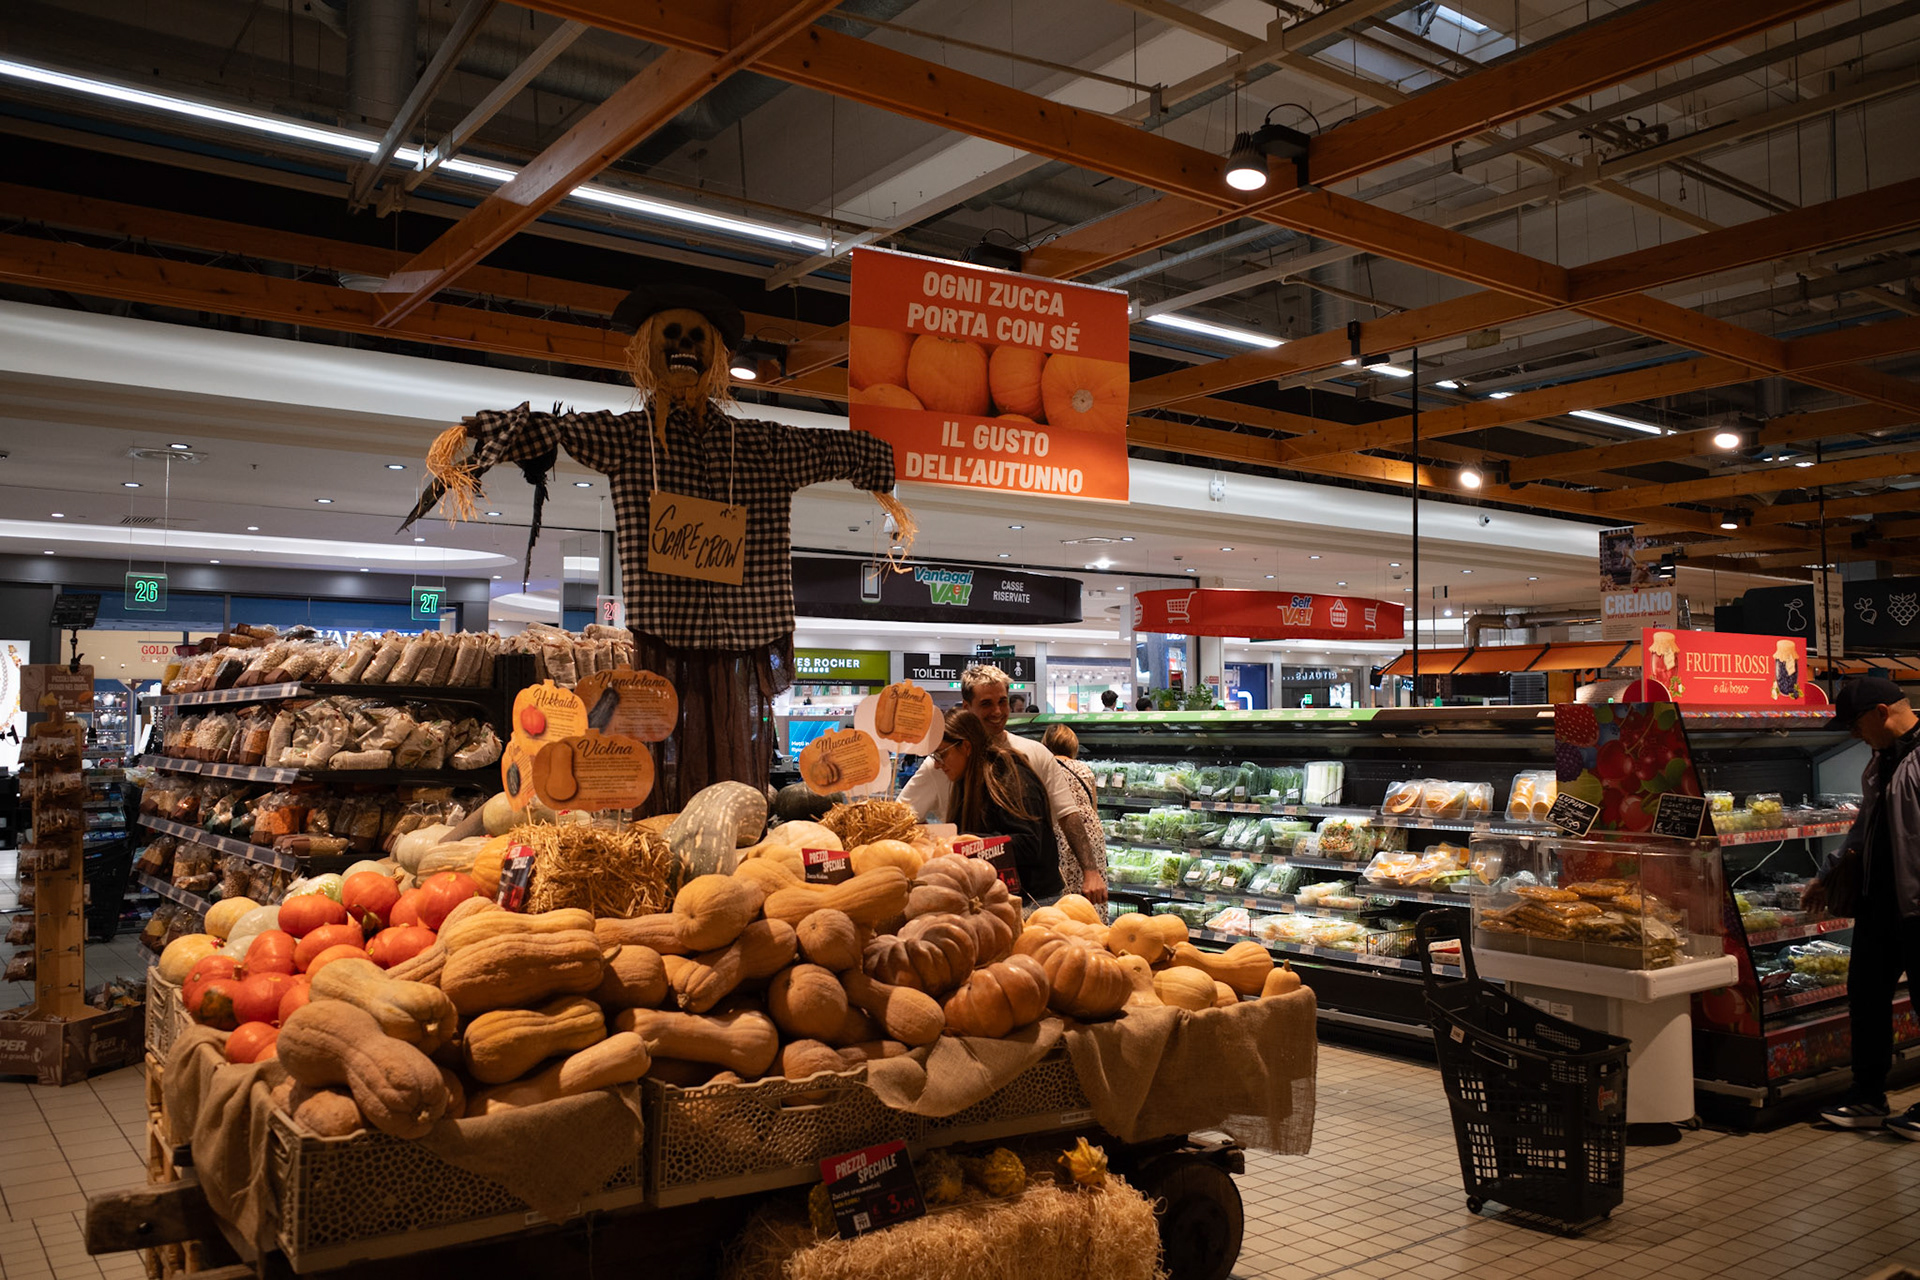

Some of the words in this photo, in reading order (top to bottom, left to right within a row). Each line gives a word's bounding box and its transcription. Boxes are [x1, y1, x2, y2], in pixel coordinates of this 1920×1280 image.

[923, 271, 982, 304] OGNI
[988, 281, 1064, 317] ZUCCA
[907, 302, 989, 338] PORTA
[996, 316, 1043, 347] CON
[1049, 322, 1081, 352] SÉ
[941, 421, 966, 448] IL
[972, 424, 1049, 457] GUSTO
[905, 452, 1083, 494] DELL'AUTUNNO
[915, 567, 974, 584] Vantaggi
[135, 581, 158, 602] 26
[1001, 580, 1024, 592] CASSE
[420, 593, 438, 614] 27
[993, 591, 1030, 603] RISERVATE
[1291, 596, 1312, 608] Self
[1605, 591, 1672, 615] CREIAMO
[141, 645, 168, 655] GOLD
[814, 658, 860, 668] ROCHER
[1686, 652, 1731, 673] FRUTTI
[1734, 654, 1769, 674] ROSSI
[912, 669, 956, 679] TOILETTE
[1719, 681, 1728, 694] di
[1729, 681, 1750, 694] bosco
[533, 687, 579, 709] Hokkaido
[576, 739, 634, 758] Violina
[815, 731, 863, 752] Muscade
[1559, 795, 1587, 810] LUPINI
[961, 839, 984, 856] PREZZO
[977, 843, 1005, 860] SPECIALE
[809, 850, 828, 864] PREZZO
[823, 858, 846, 873] SPECIALE
[835, 1153, 867, 1180] PREZZO
[857, 1154, 897, 1184] SPECIALE
